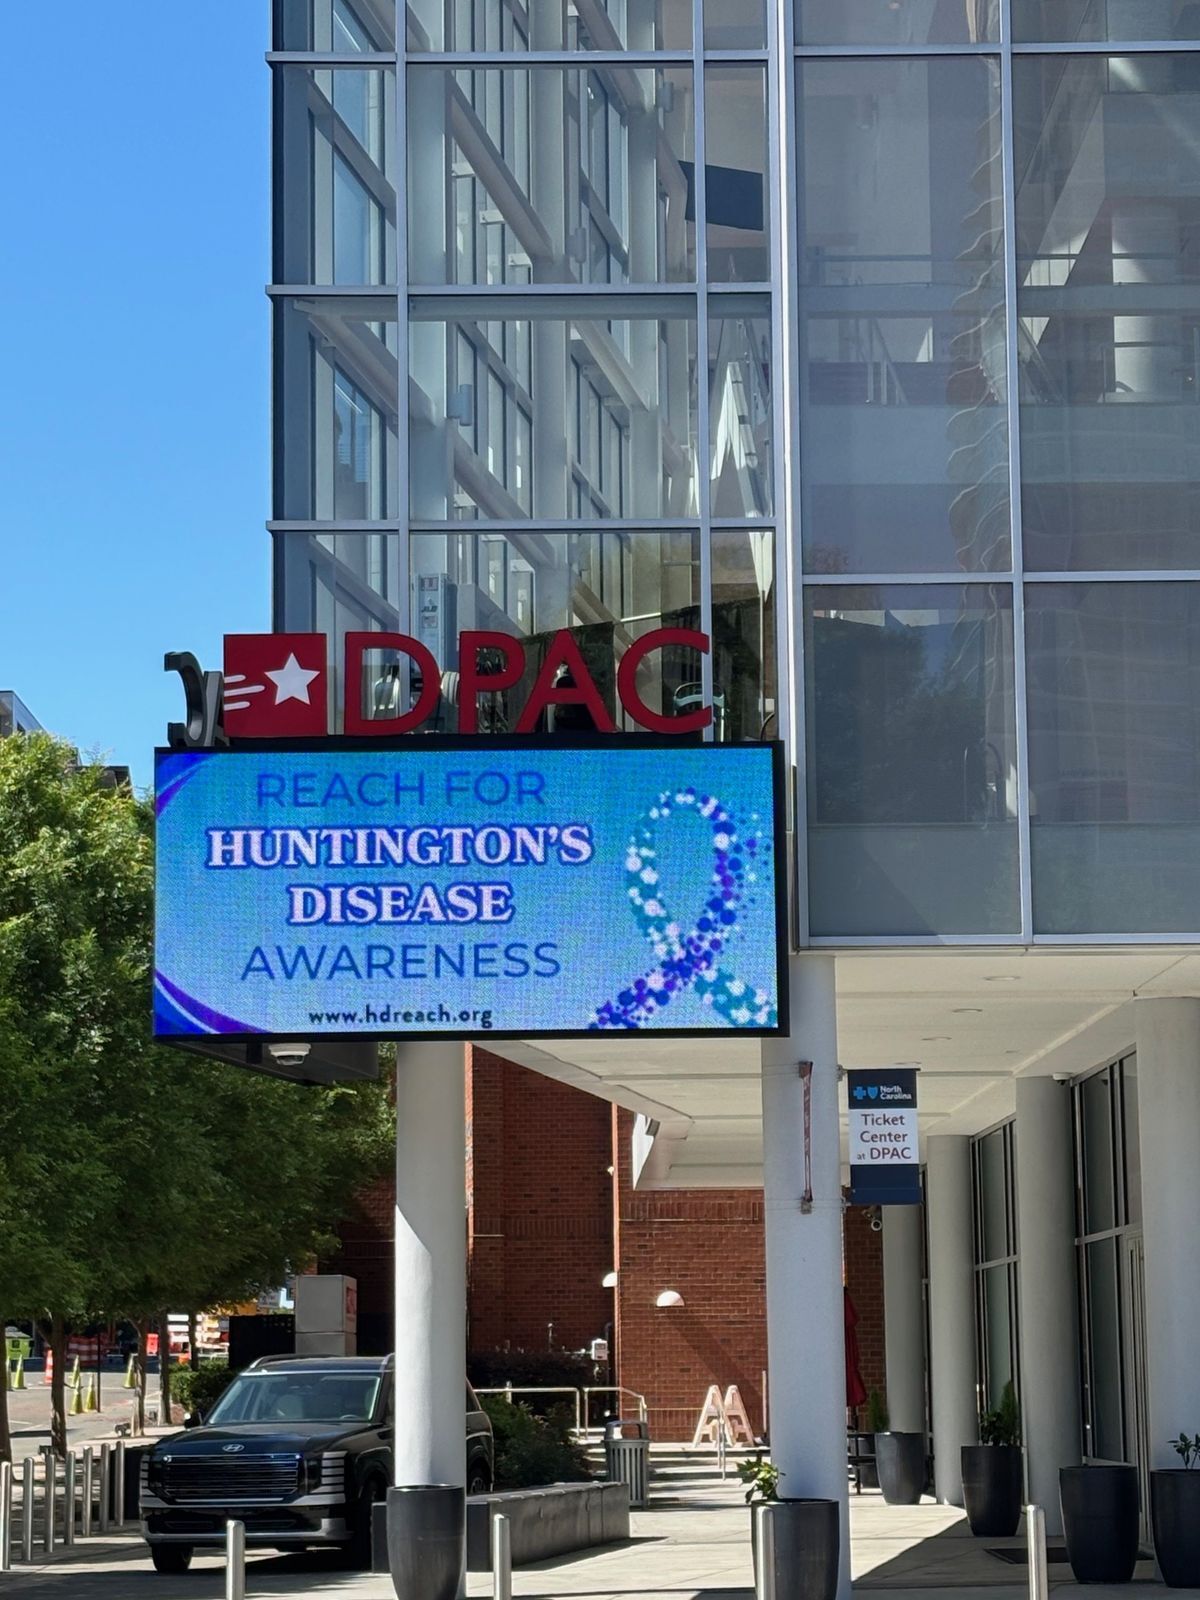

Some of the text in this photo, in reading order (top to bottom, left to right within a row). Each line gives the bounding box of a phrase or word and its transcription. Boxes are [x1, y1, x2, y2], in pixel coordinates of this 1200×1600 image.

[344, 627, 713, 736] DPAC
[256, 770, 546, 808] REACH FOR
[207, 825, 593, 868] HUNTINGTON'S
[288, 884, 514, 925] DISEASE
[240, 942, 561, 981] AWARENESS
[308, 1004, 493, 1029] www.hdreach.org
[880, 1085, 901, 1093] North
[880, 1092, 912, 1100] Carolina
[861, 1113, 905, 1126] Ticket
[860, 1130, 908, 1143] Center
[857, 1147, 911, 1160] at DPAC
